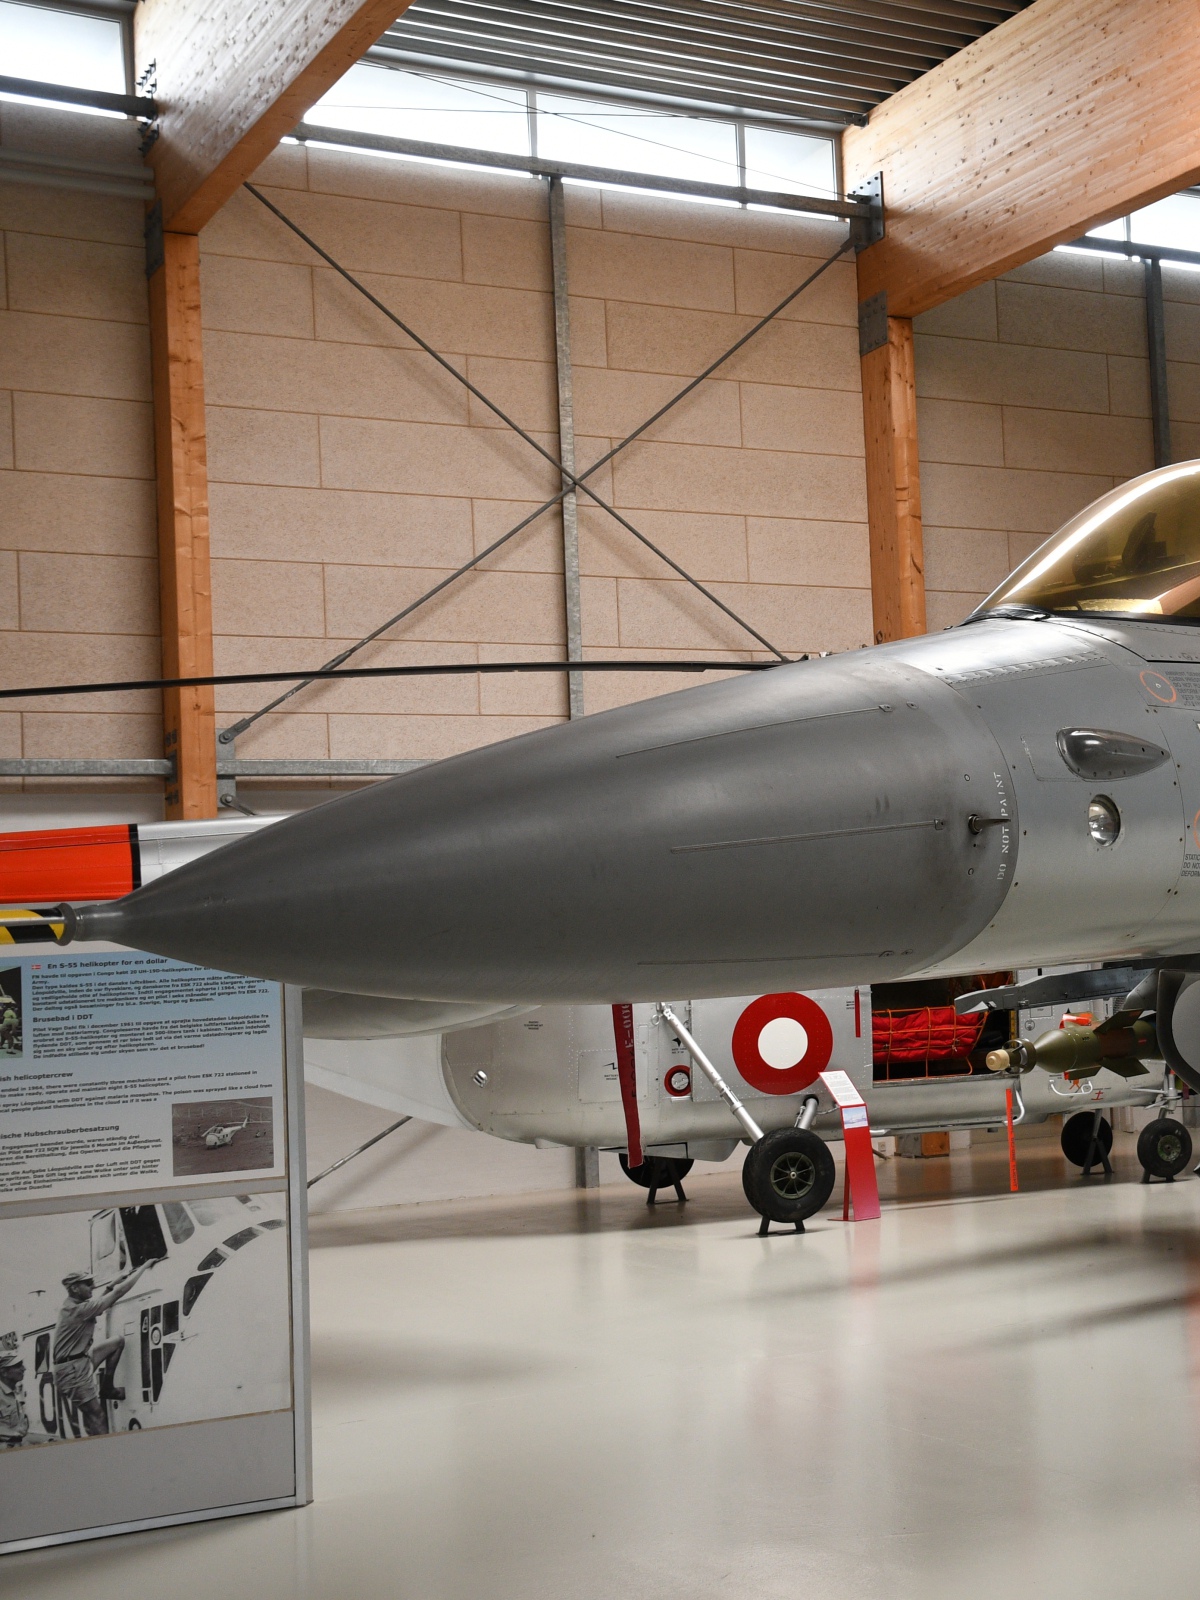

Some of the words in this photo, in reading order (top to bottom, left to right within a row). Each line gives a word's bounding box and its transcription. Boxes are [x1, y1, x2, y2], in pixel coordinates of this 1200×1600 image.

[993, 772, 1008, 817] PAINT
[996, 863, 1006, 880] DO
[79, 960, 118, 969] helikopter
[32, 1014, 70, 1022] Brusebad
[13, 1072, 73, 1081] helicoptercrew
[23, 1124, 119, 1137] Hubschrauberbesatzung
